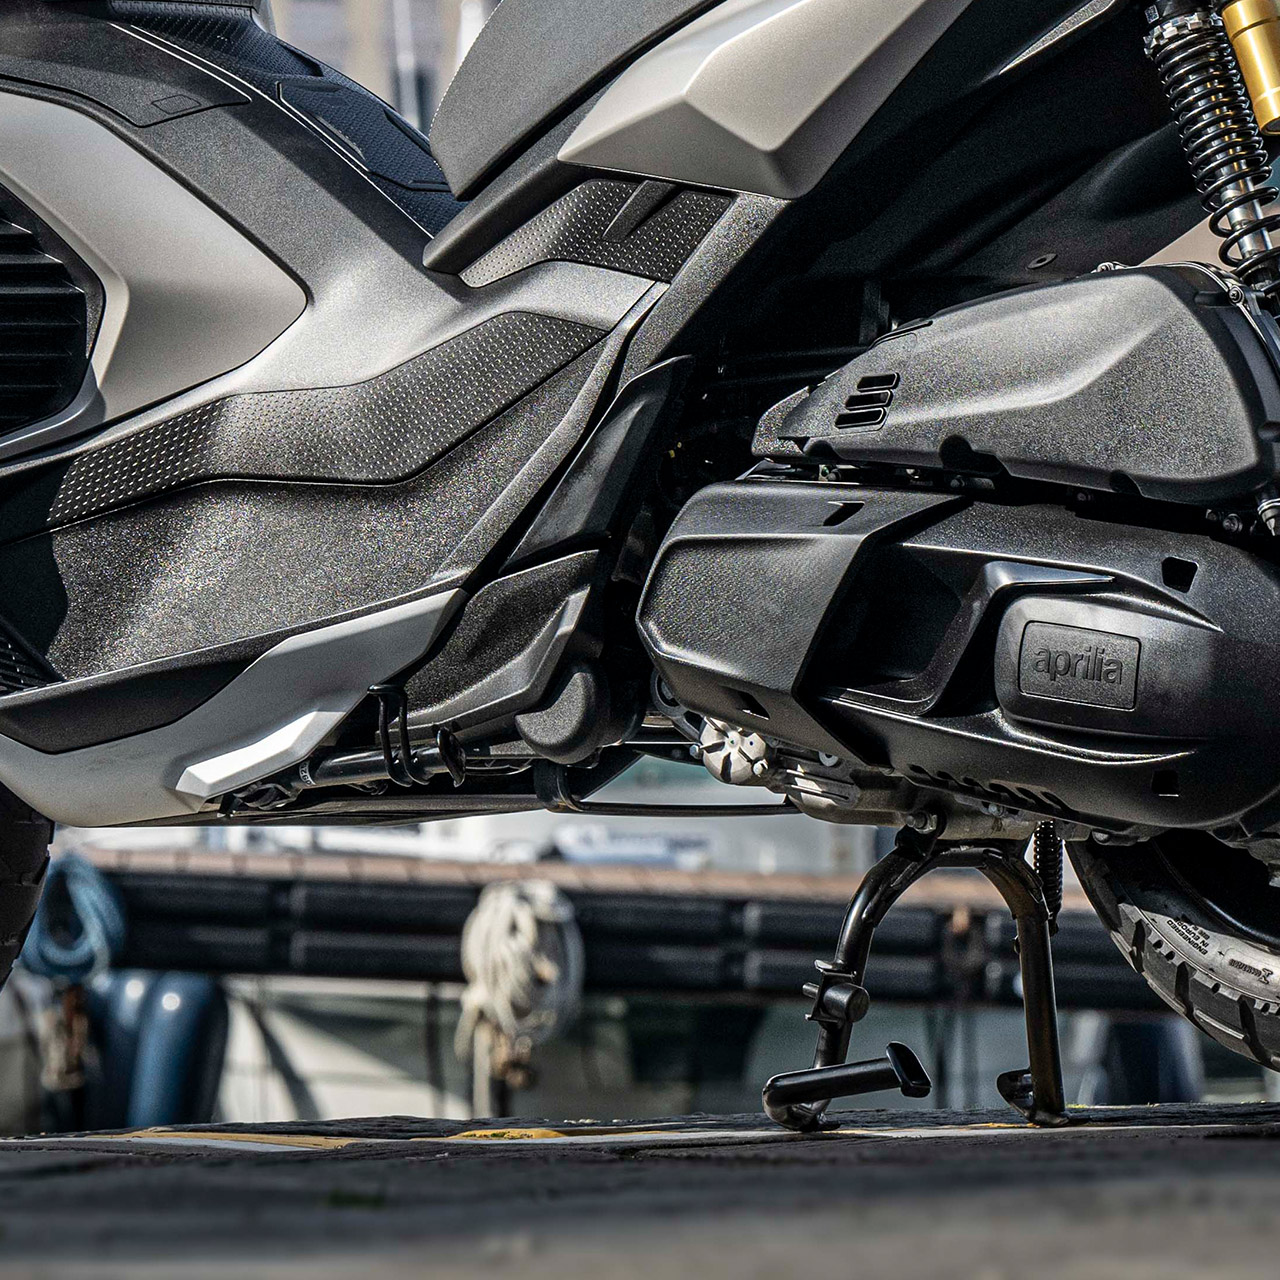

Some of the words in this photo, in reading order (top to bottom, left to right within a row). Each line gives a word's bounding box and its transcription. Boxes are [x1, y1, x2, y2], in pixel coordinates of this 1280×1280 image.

[1032, 645, 1123, 685] aprilia
[1166, 919, 1208, 956] ENGINEERED
[1201, 939, 1209, 948] IN
